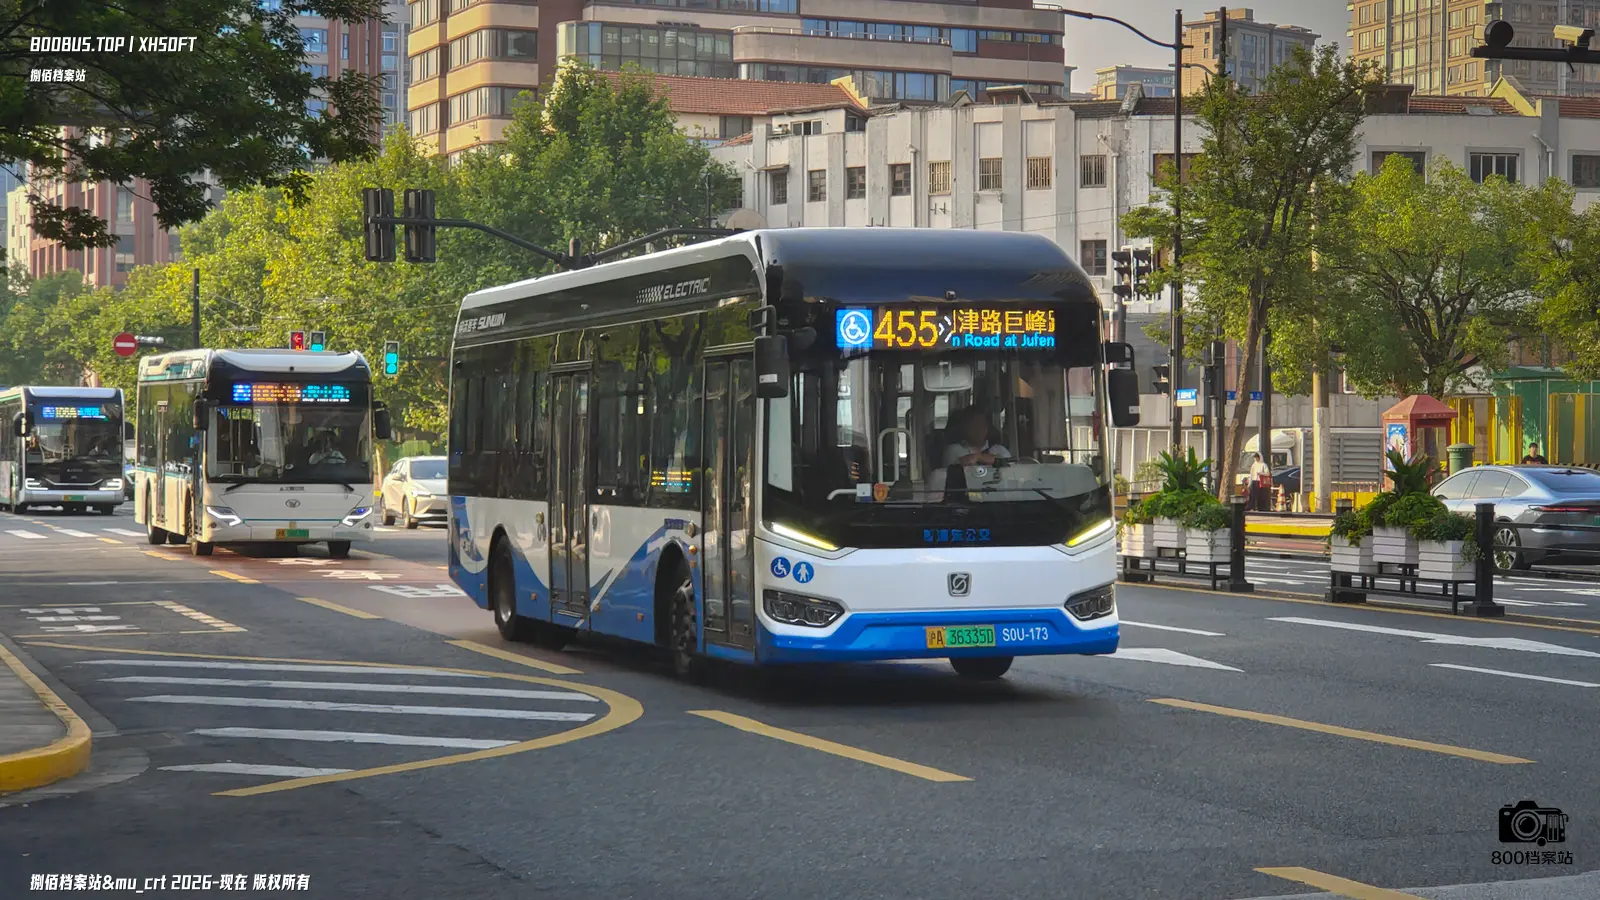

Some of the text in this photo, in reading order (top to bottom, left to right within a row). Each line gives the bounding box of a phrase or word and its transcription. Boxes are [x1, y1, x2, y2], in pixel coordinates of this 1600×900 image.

[663, 277, 710, 299] ELECTRIC
[873, 310, 938, 347] 455
[964, 333, 1000, 347] Road
[1004, 334, 1018, 347] at
[1021, 332, 1055, 347] Jufen
